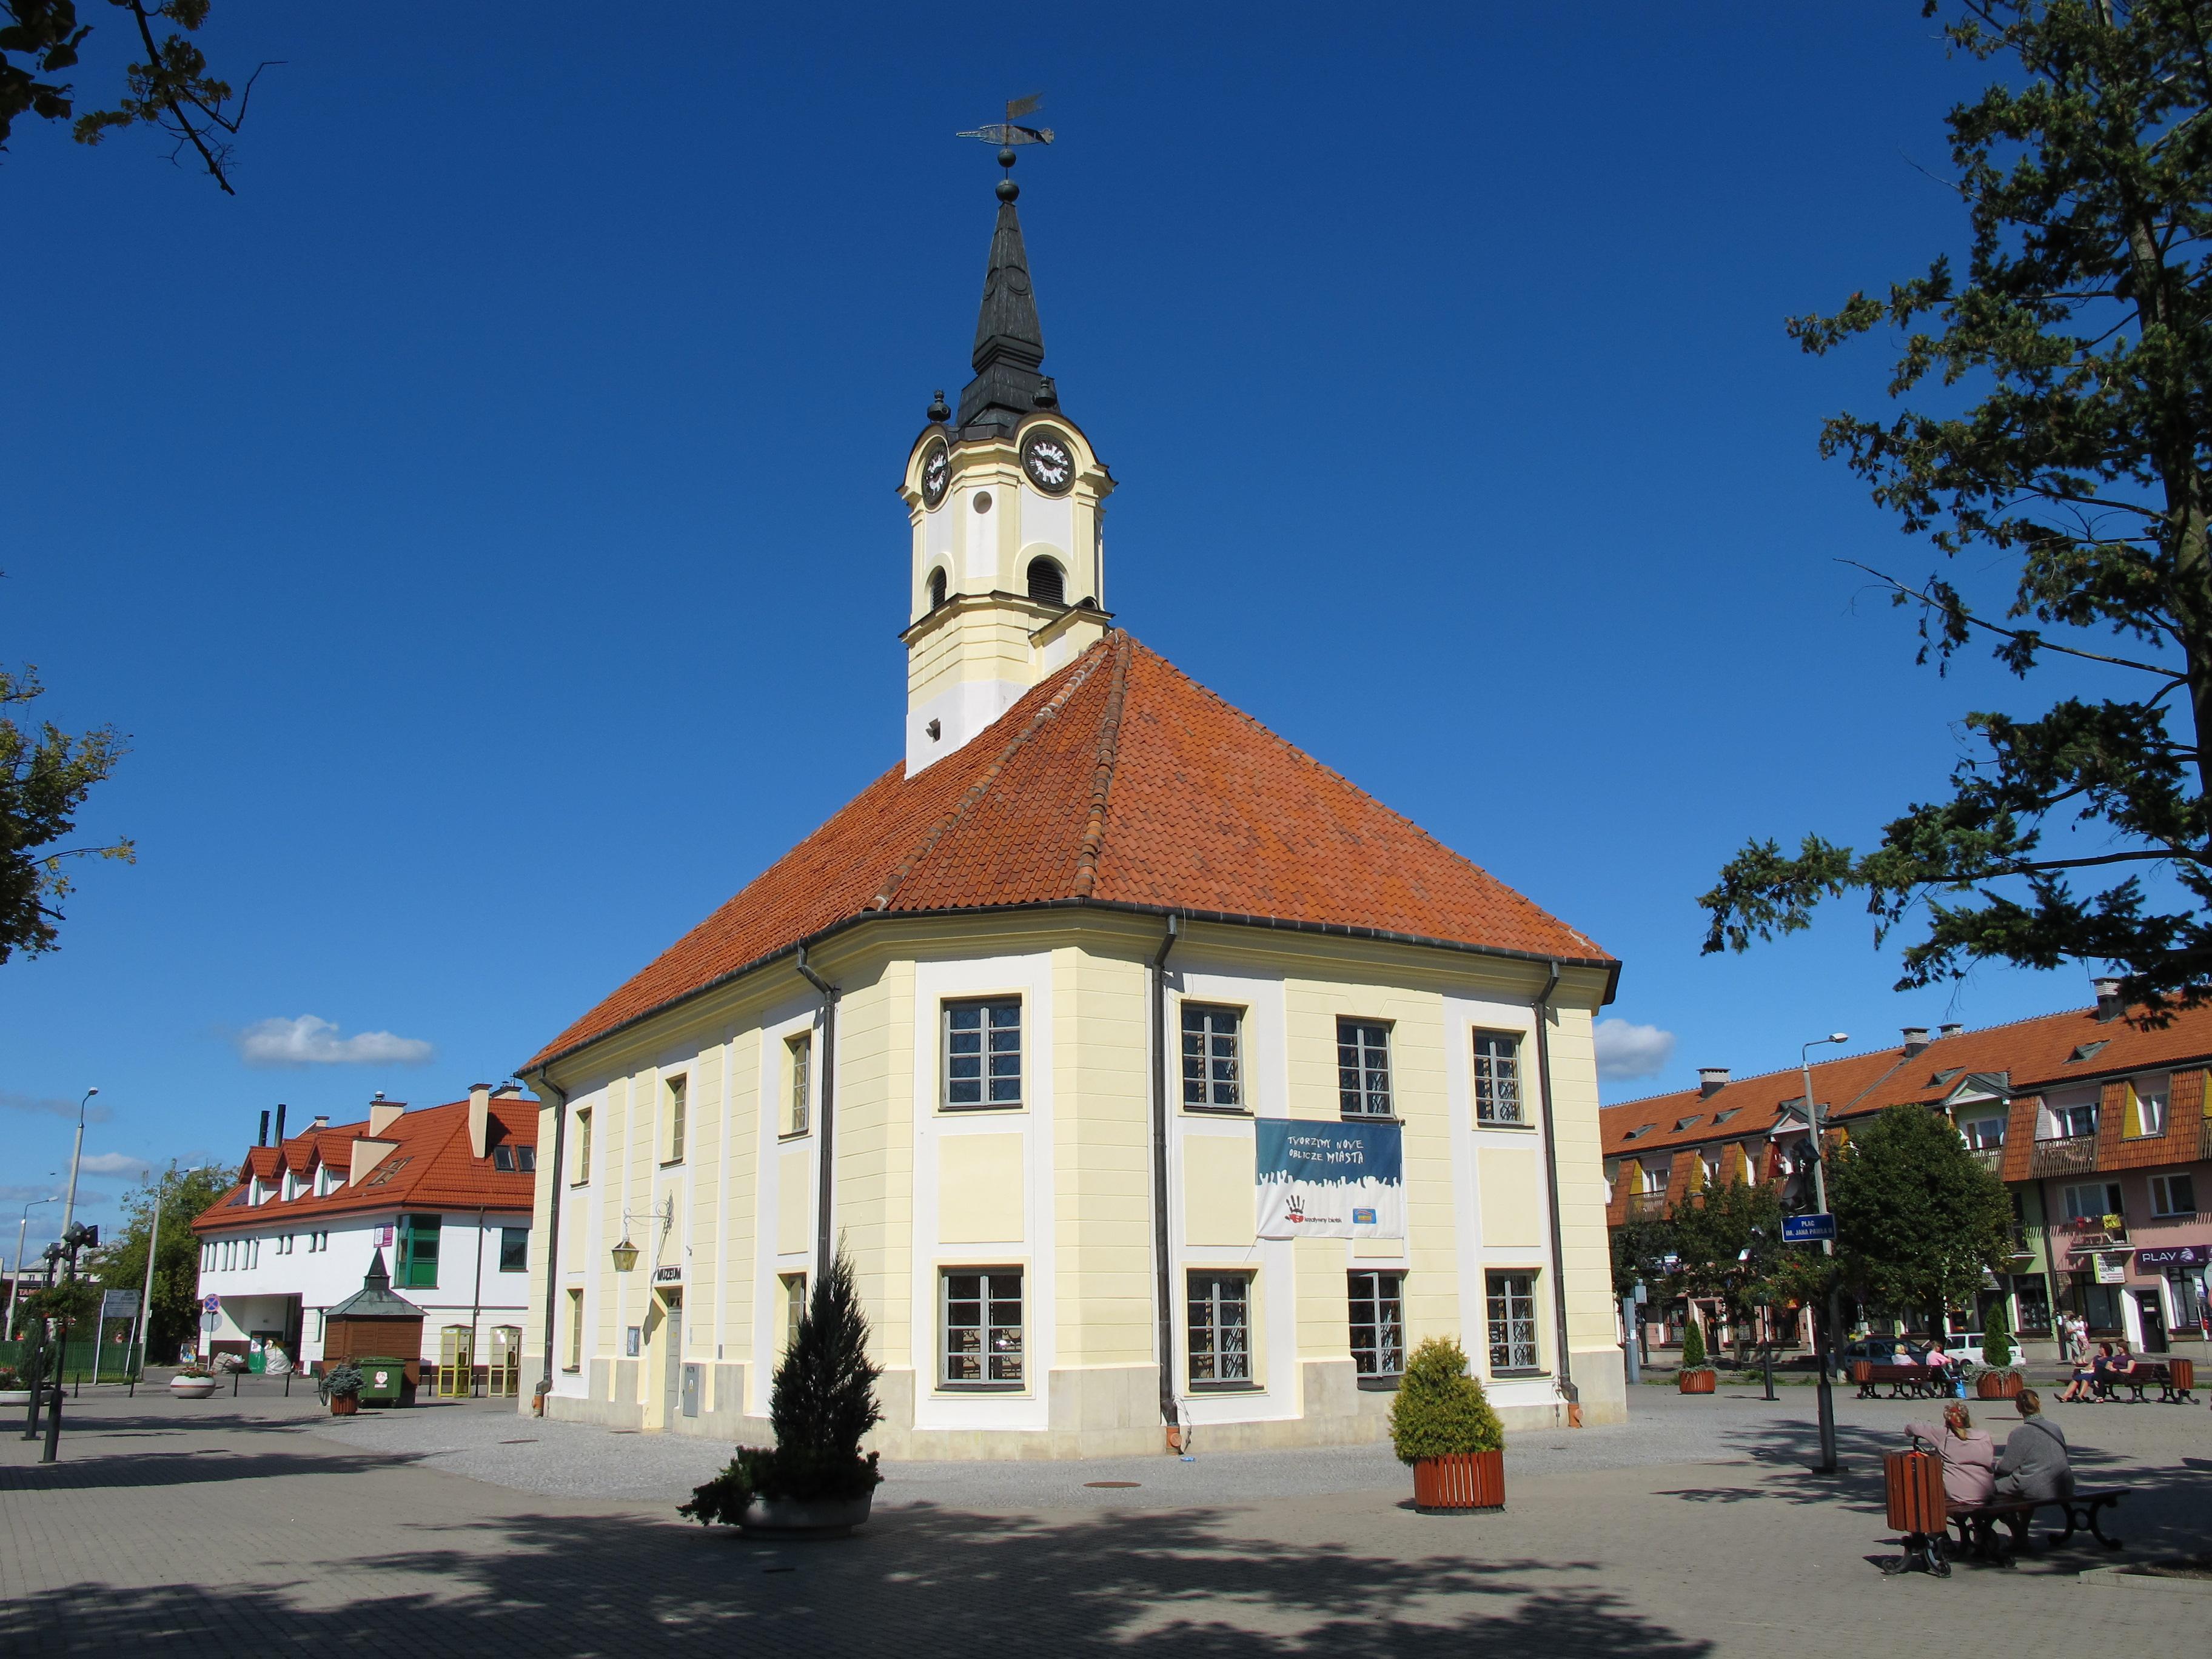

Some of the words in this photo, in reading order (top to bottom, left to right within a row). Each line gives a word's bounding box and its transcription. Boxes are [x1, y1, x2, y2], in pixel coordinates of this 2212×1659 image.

[1289, 1148, 1324, 1161] OBLICZE
[1326, 1151, 1364, 1164] MIASTA
[2142, 1252, 2177, 1262] PLAY
[657, 1267, 682, 1281] MUZEUM
